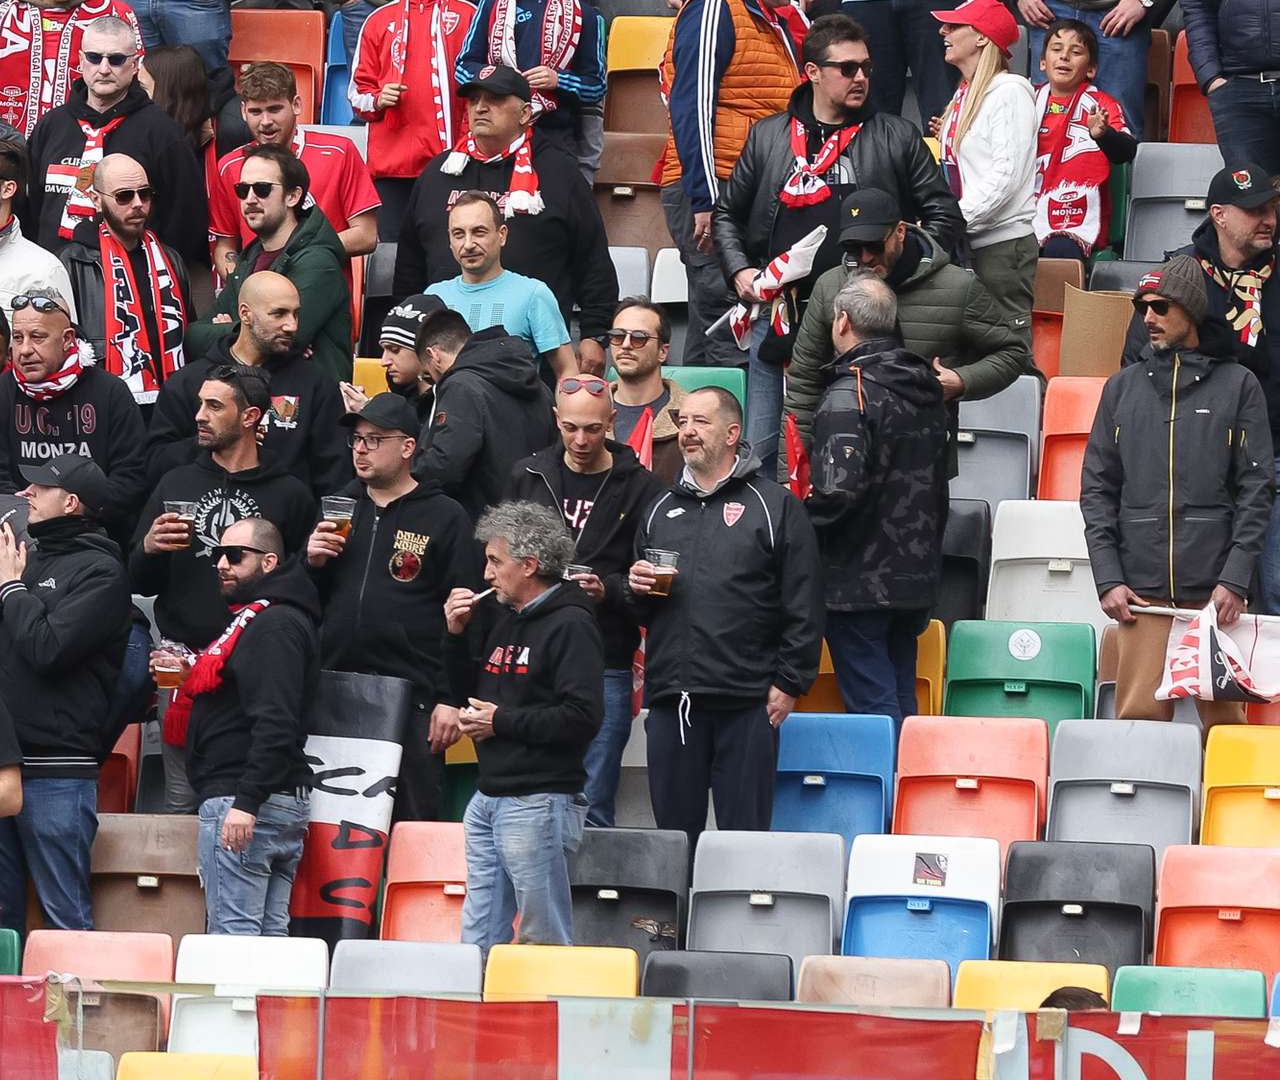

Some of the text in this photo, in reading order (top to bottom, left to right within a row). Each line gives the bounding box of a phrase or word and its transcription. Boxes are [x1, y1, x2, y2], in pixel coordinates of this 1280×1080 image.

[32, 13, 41, 43] FORZA
[59, 23, 75, 50] FORZA
[33, 46, 41, 73] BAGAI
[56, 52, 67, 80] BAGAI
[30, 76, 40, 106] FORZA
[1052, 208, 1083, 217] MONZA
[20, 441, 93, 460] MONZA
